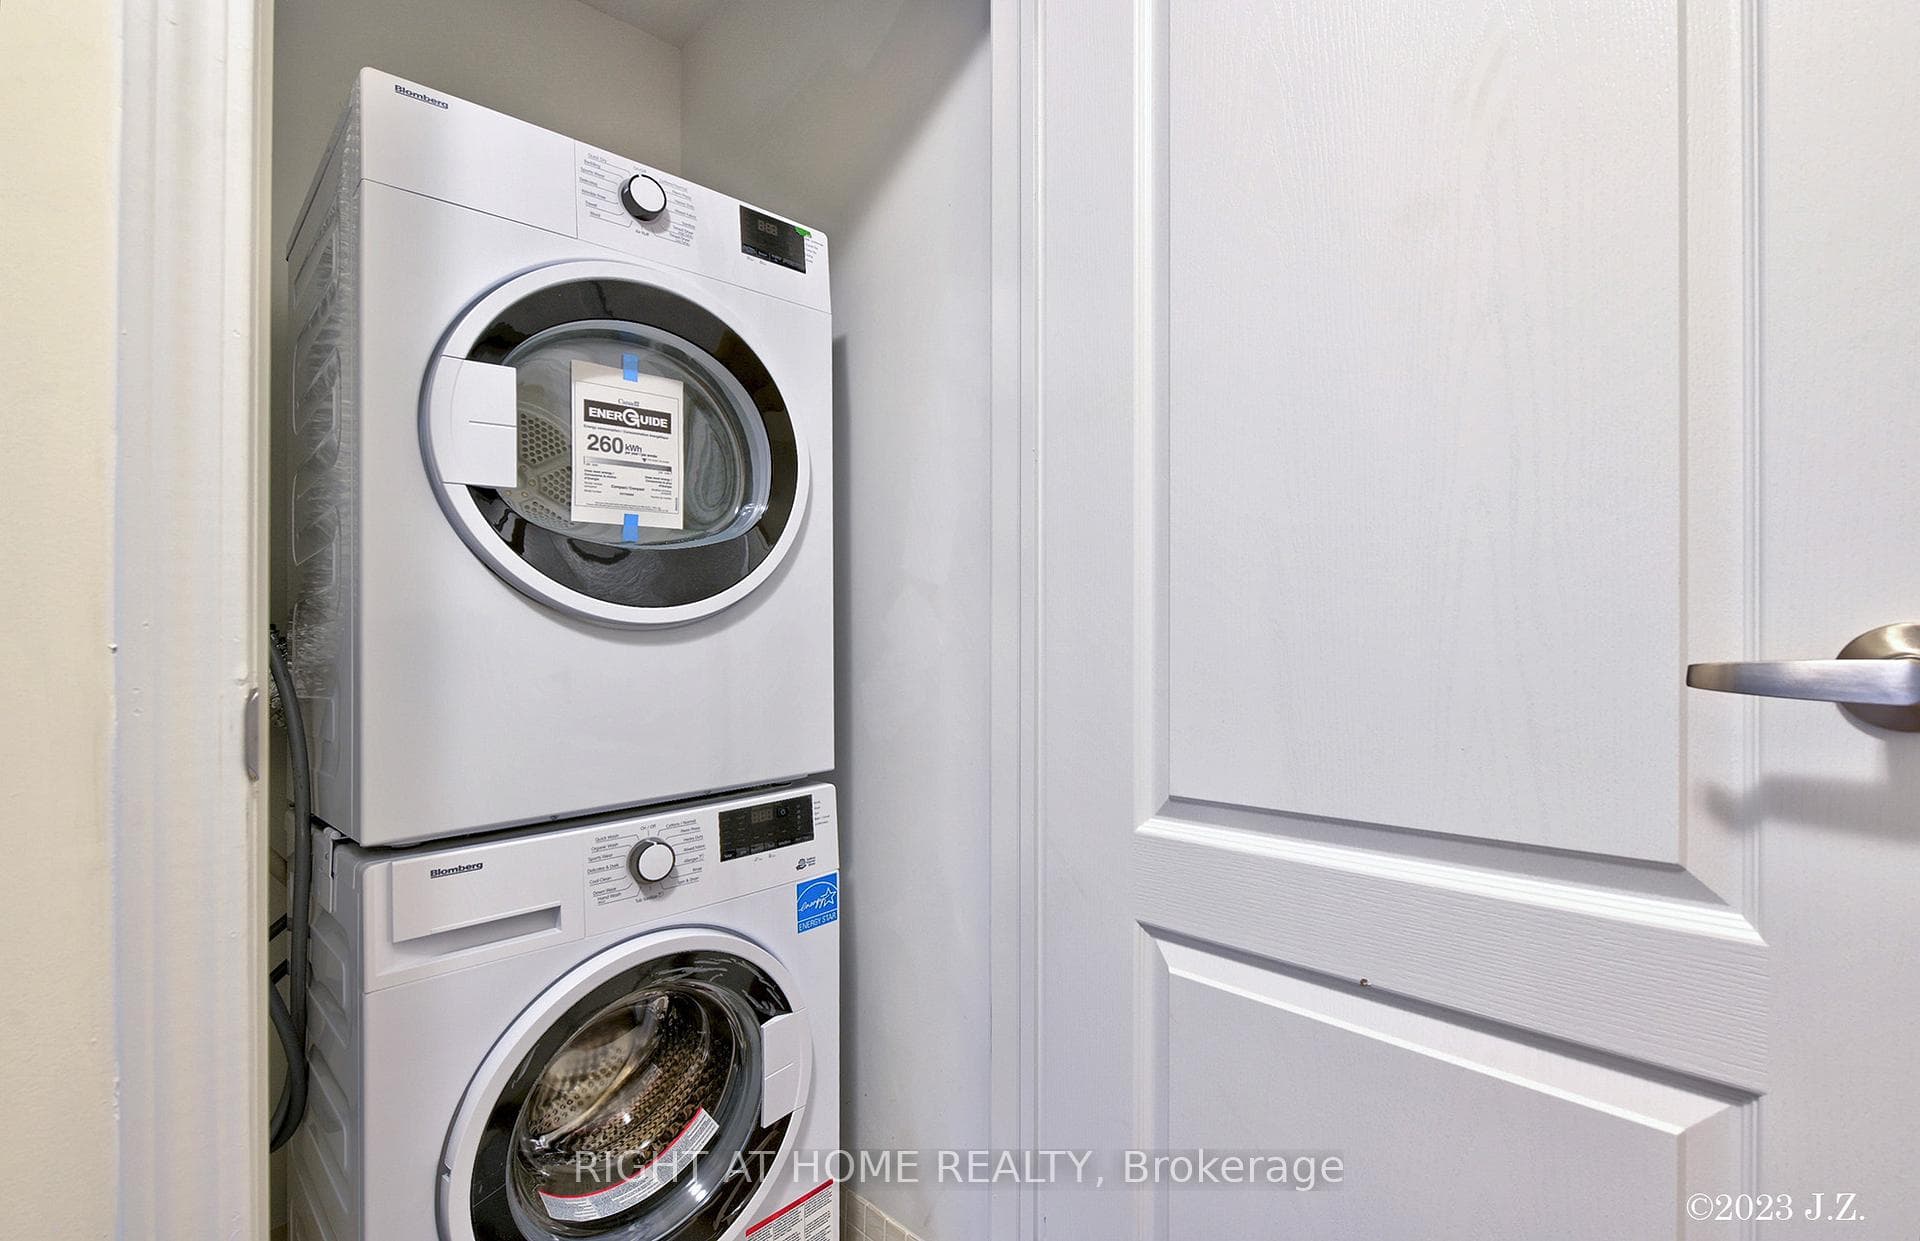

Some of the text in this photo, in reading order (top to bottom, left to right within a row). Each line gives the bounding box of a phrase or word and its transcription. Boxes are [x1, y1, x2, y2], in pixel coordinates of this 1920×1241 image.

[395, 84, 448, 109] Blomberg
[588, 407, 669, 429] ENERGUIDE
[587, 434, 643, 454] 260 kWh
[430, 862, 483, 879] Blomberg
[799, 911, 837, 932] ENERGY STAR
